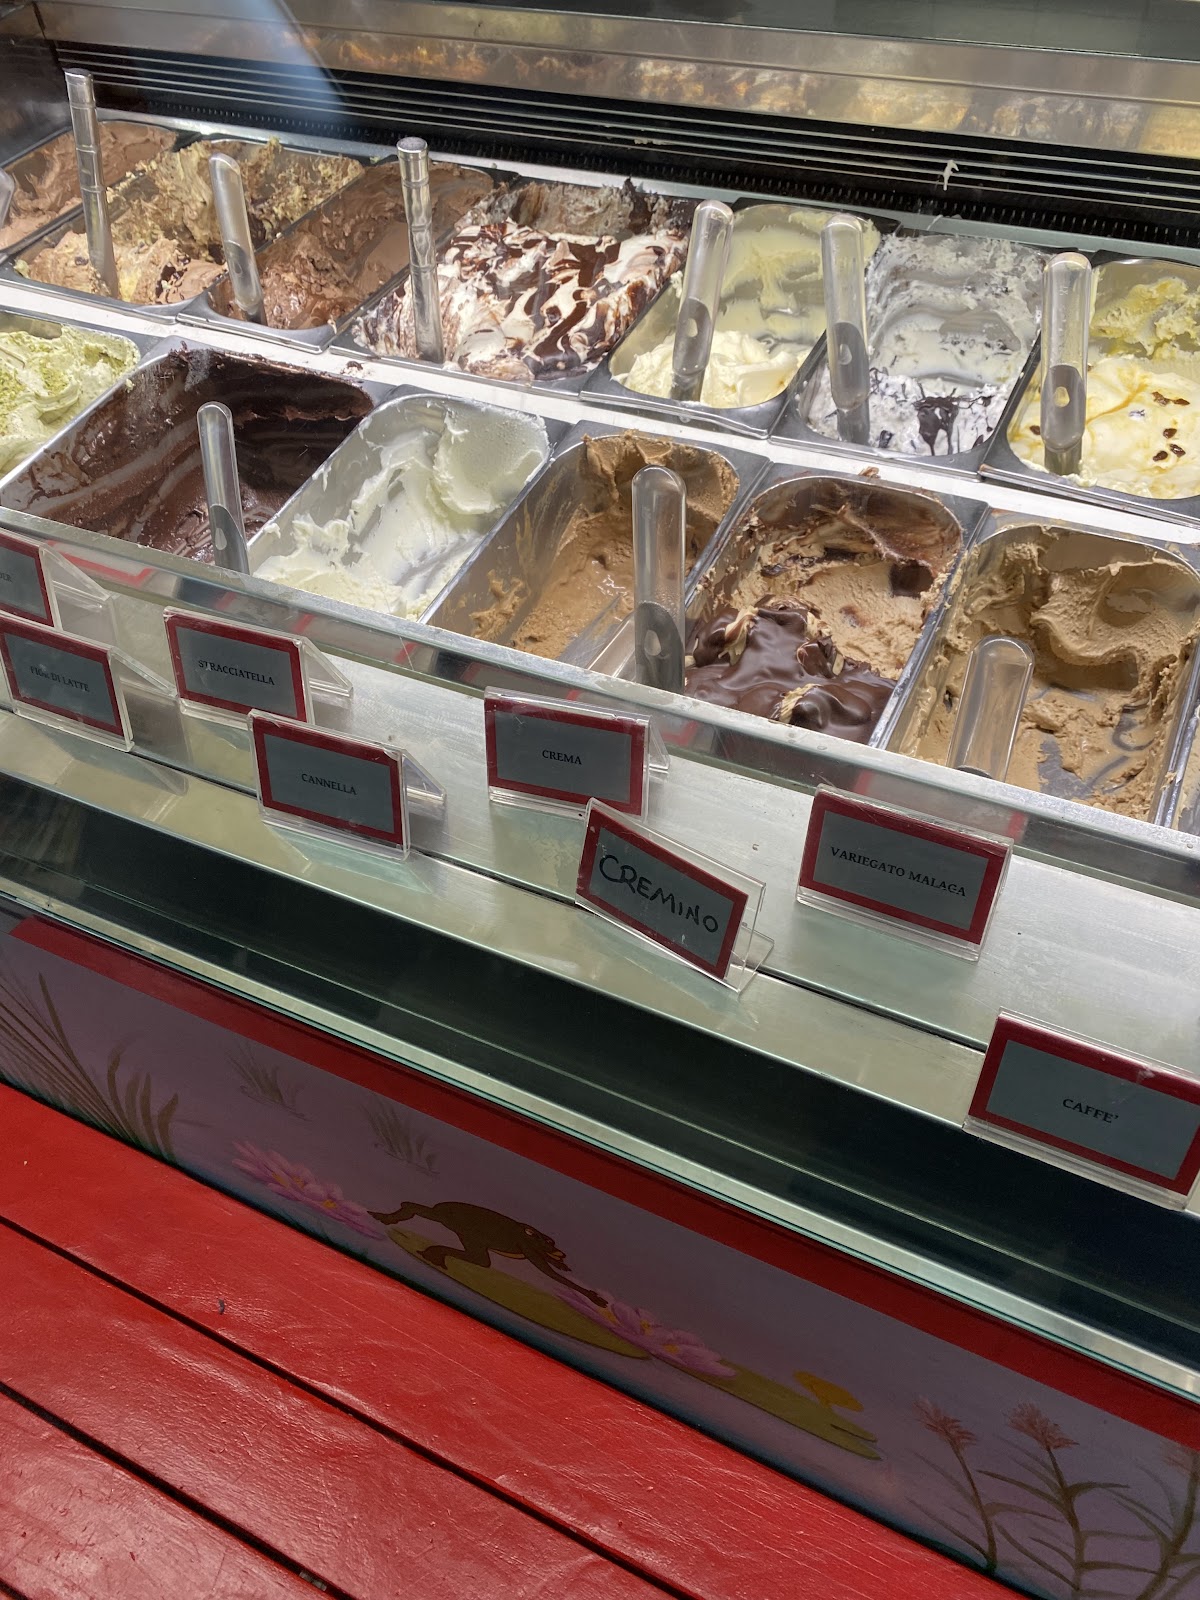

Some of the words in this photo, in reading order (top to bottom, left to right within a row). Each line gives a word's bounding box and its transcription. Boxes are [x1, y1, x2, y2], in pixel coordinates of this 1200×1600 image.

[51, 672, 61, 683] DI
[62, 676, 90, 693] LATTE
[198, 659, 275, 686] STRACCIATELLA
[541, 749, 583, 765] CREMA
[301, 773, 358, 796] CANNELLA
[830, 846, 905, 877] VARIEGATO
[908, 870, 967, 897] MALAGA
[598, 854, 719, 933] CREMINO
